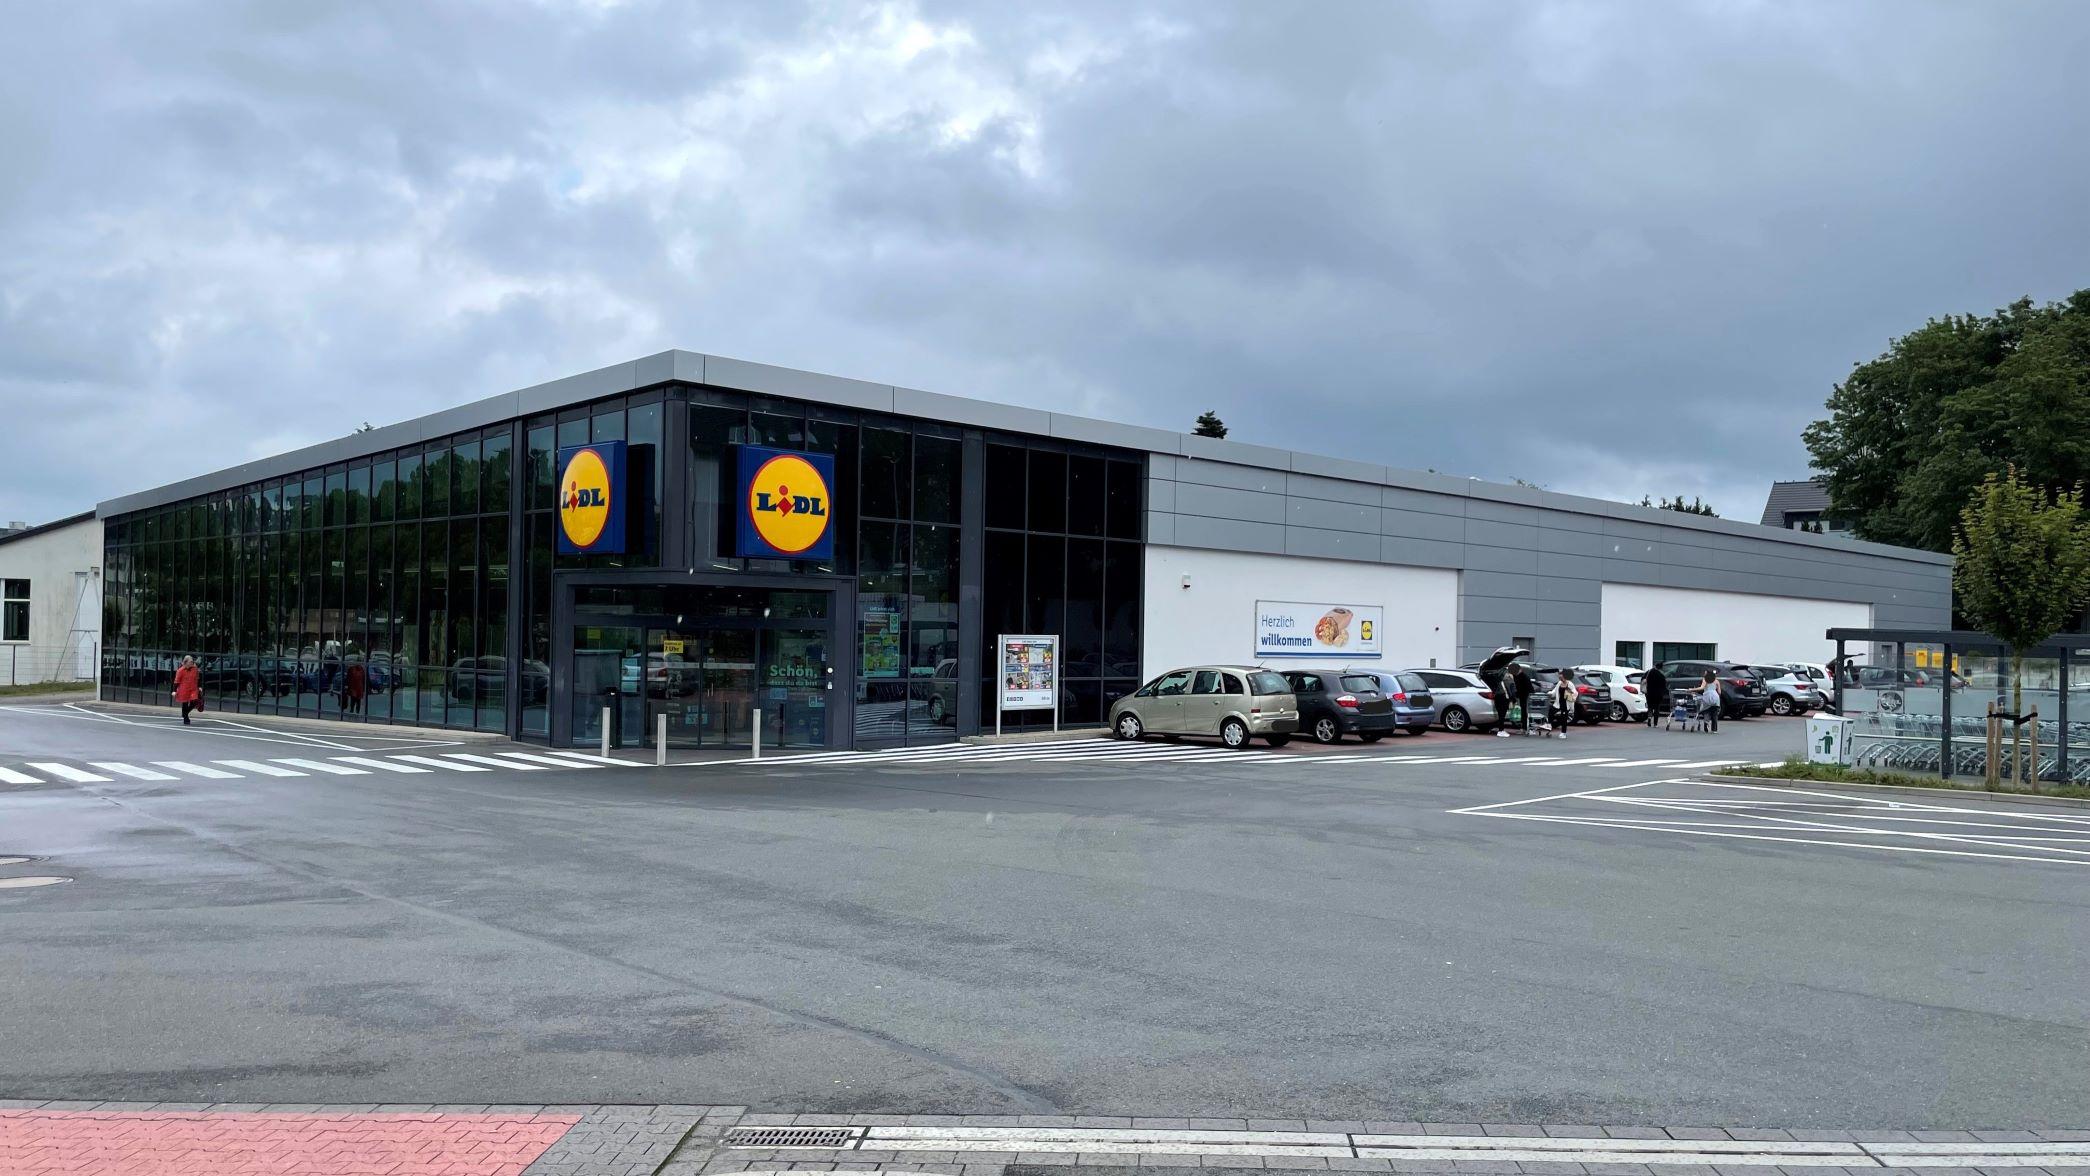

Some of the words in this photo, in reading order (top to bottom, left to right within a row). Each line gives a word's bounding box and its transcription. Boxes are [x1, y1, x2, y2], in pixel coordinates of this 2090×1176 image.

[1261, 615, 1295, 628] Herzlich
[1261, 633, 1312, 647] willkommen
[769, 664, 818, 679] Schön,
